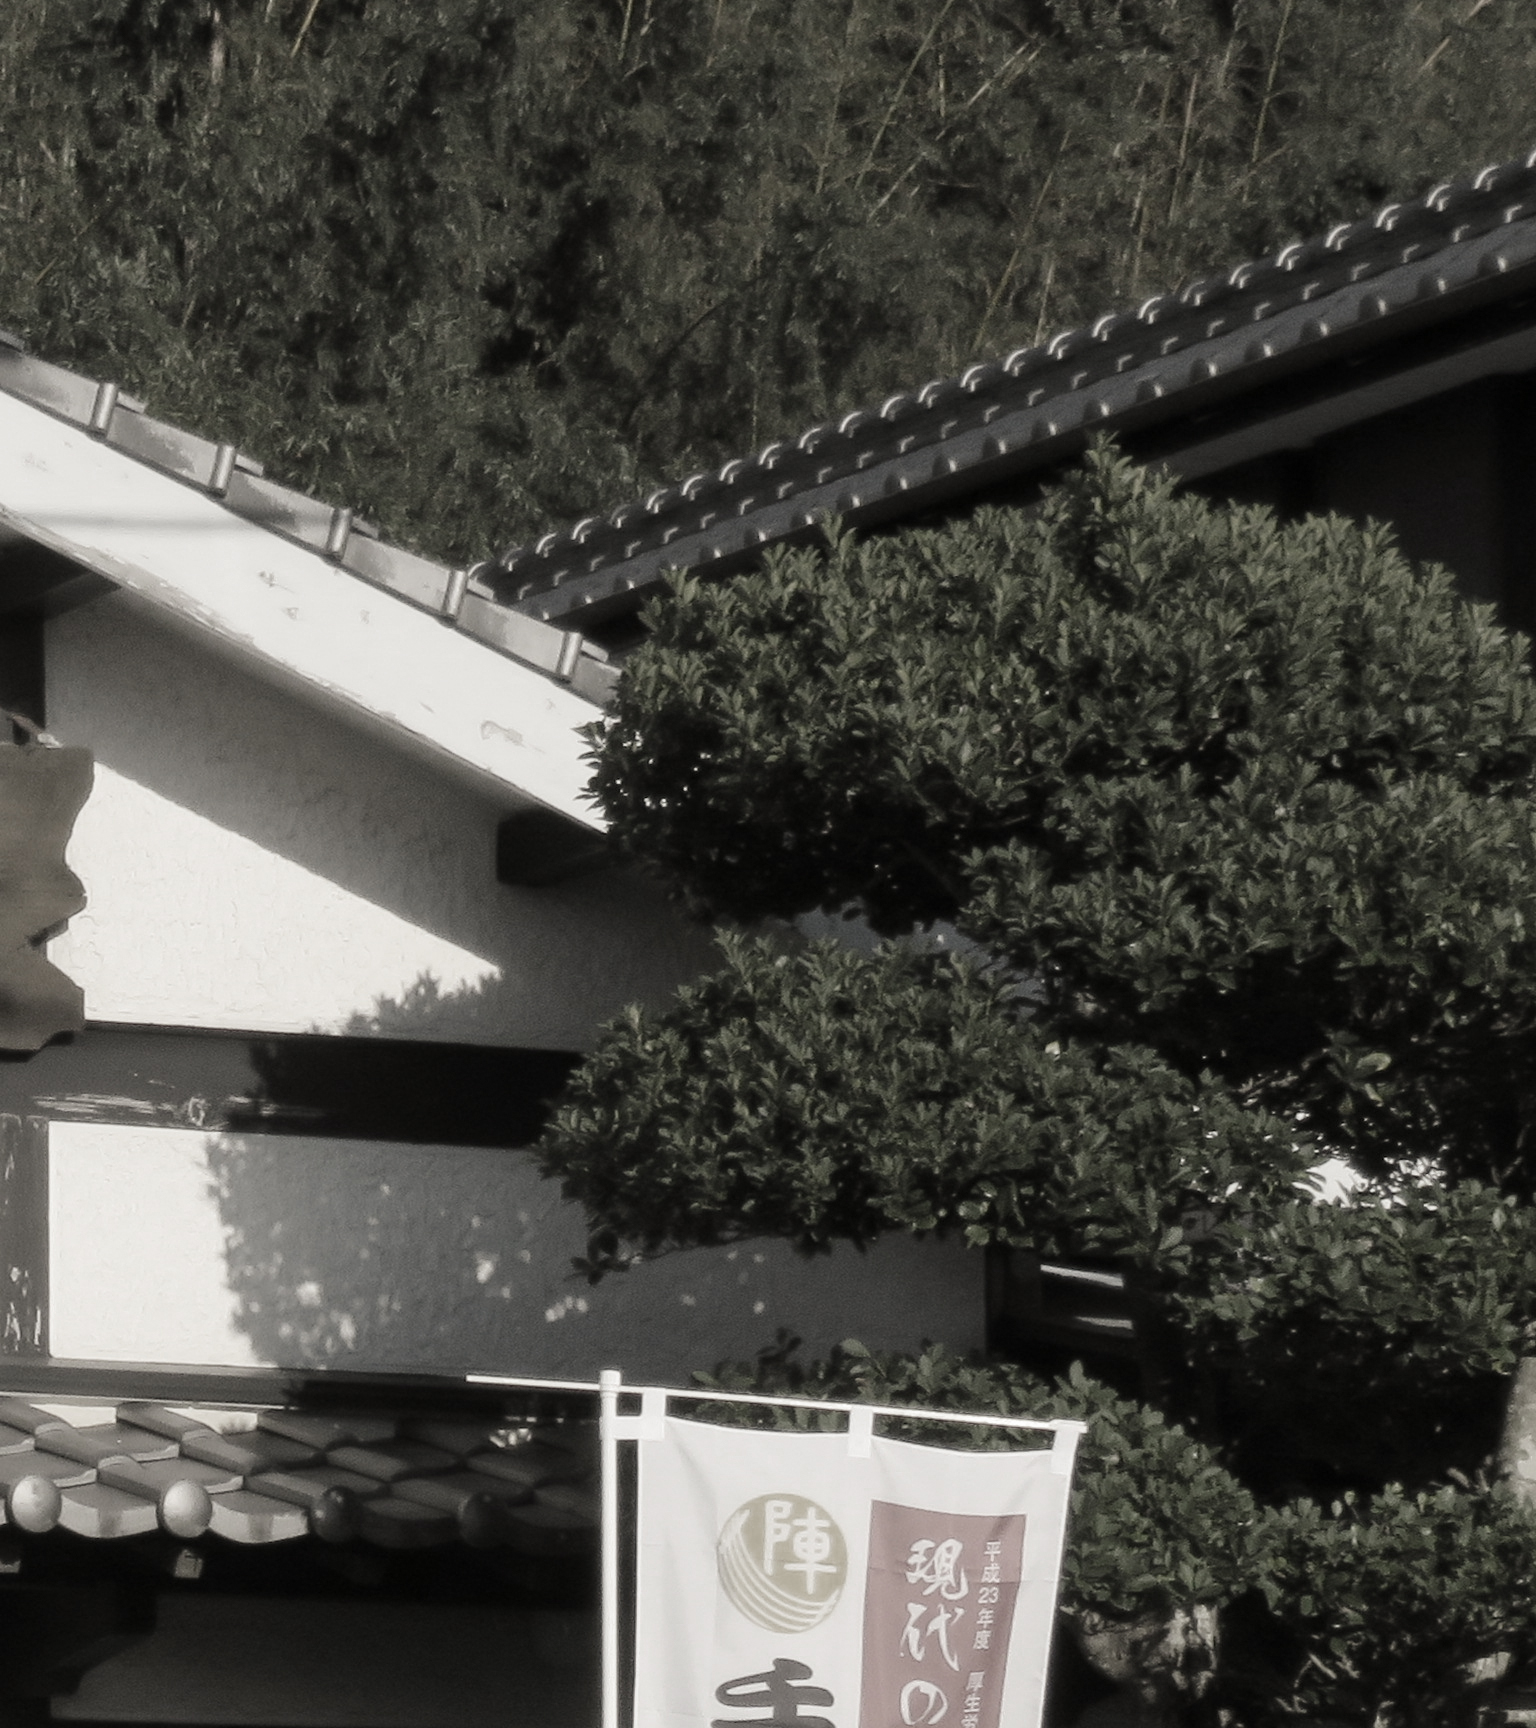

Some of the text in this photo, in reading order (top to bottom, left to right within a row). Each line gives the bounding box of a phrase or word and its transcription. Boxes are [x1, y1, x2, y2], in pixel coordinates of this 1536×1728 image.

[761, 1499, 838, 1594] 陣
[972, 1540, 1003, 1651] 平成23年度
